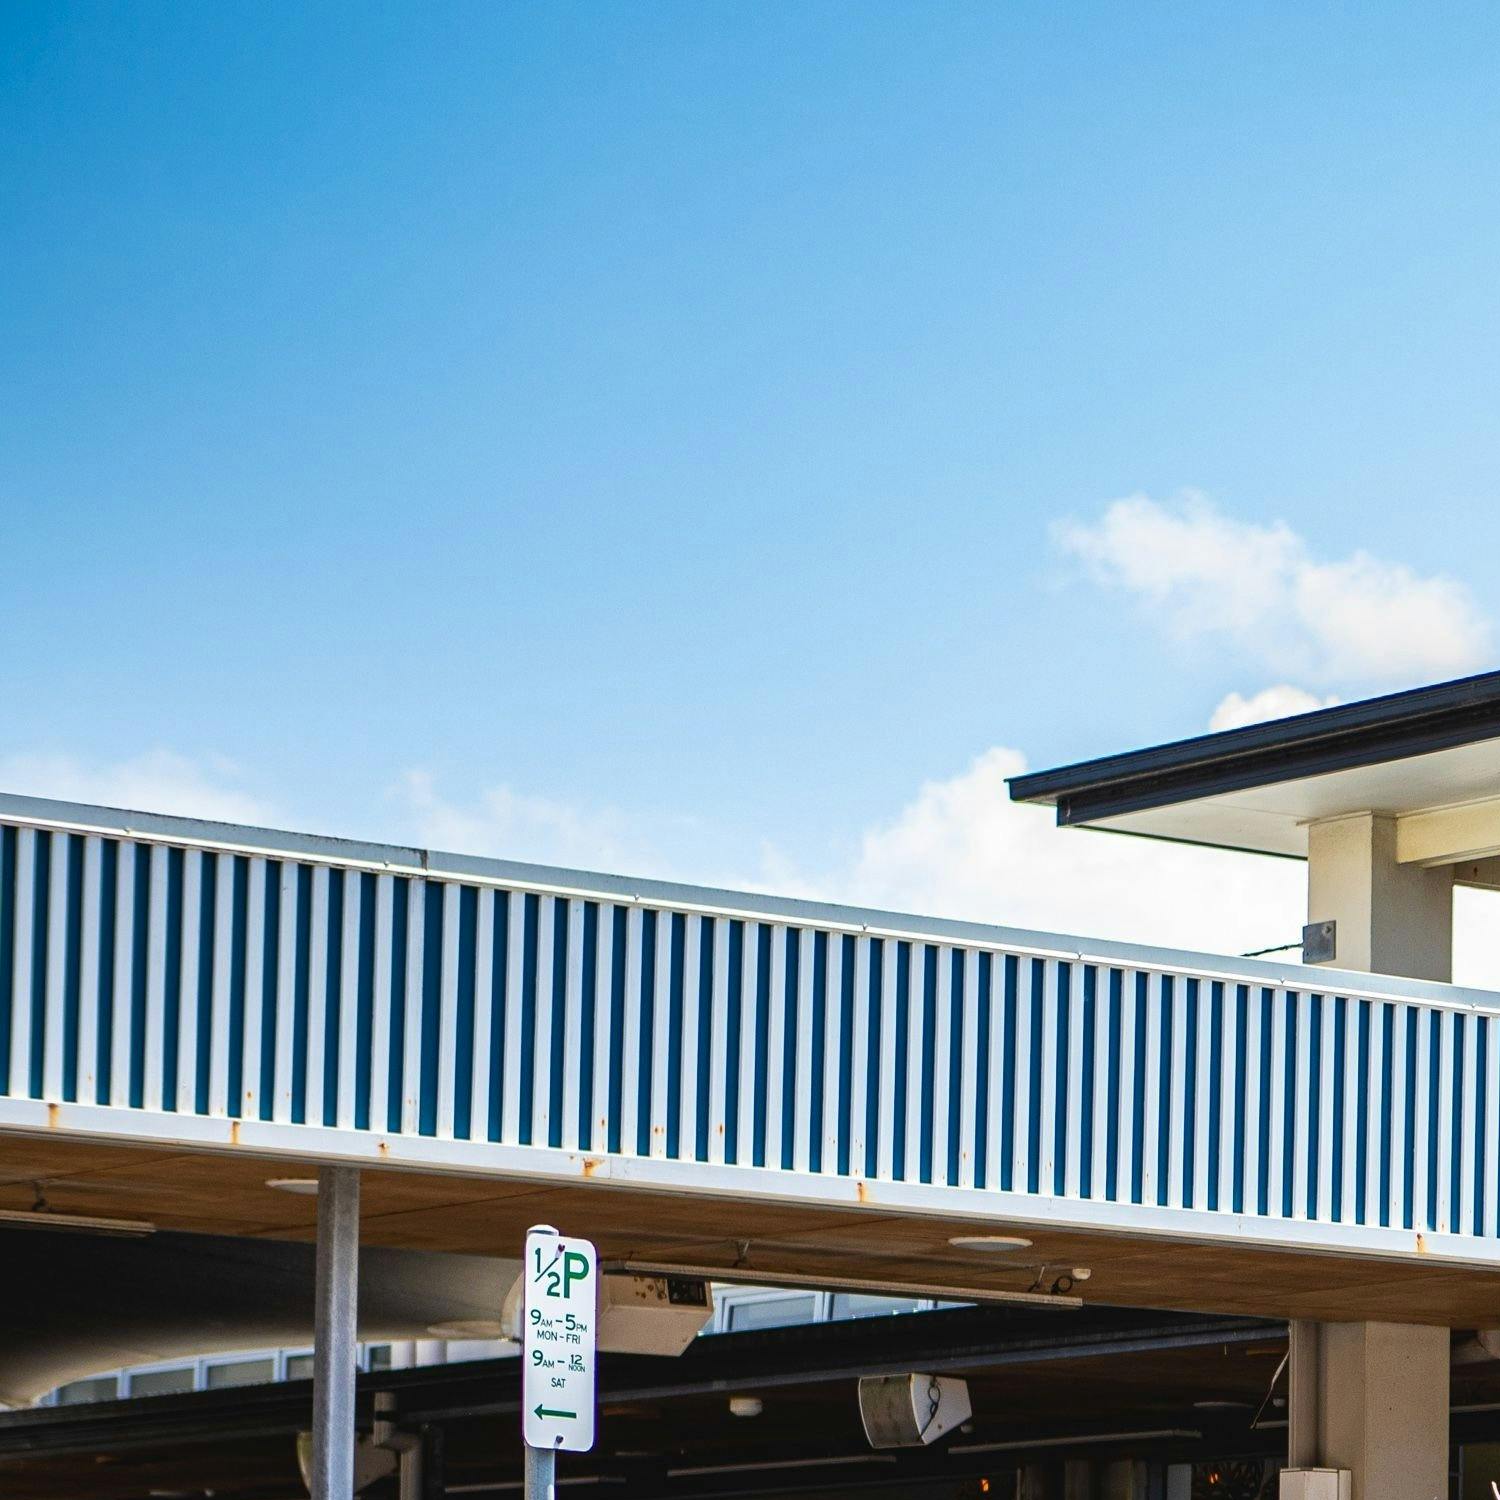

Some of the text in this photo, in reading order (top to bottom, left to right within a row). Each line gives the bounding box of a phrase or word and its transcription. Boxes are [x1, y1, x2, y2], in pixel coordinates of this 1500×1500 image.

[570, 1354, 583, 1365] 12
[568, 1364, 586, 1372] NOON
[551, 1377, 566, 1388] SAT
